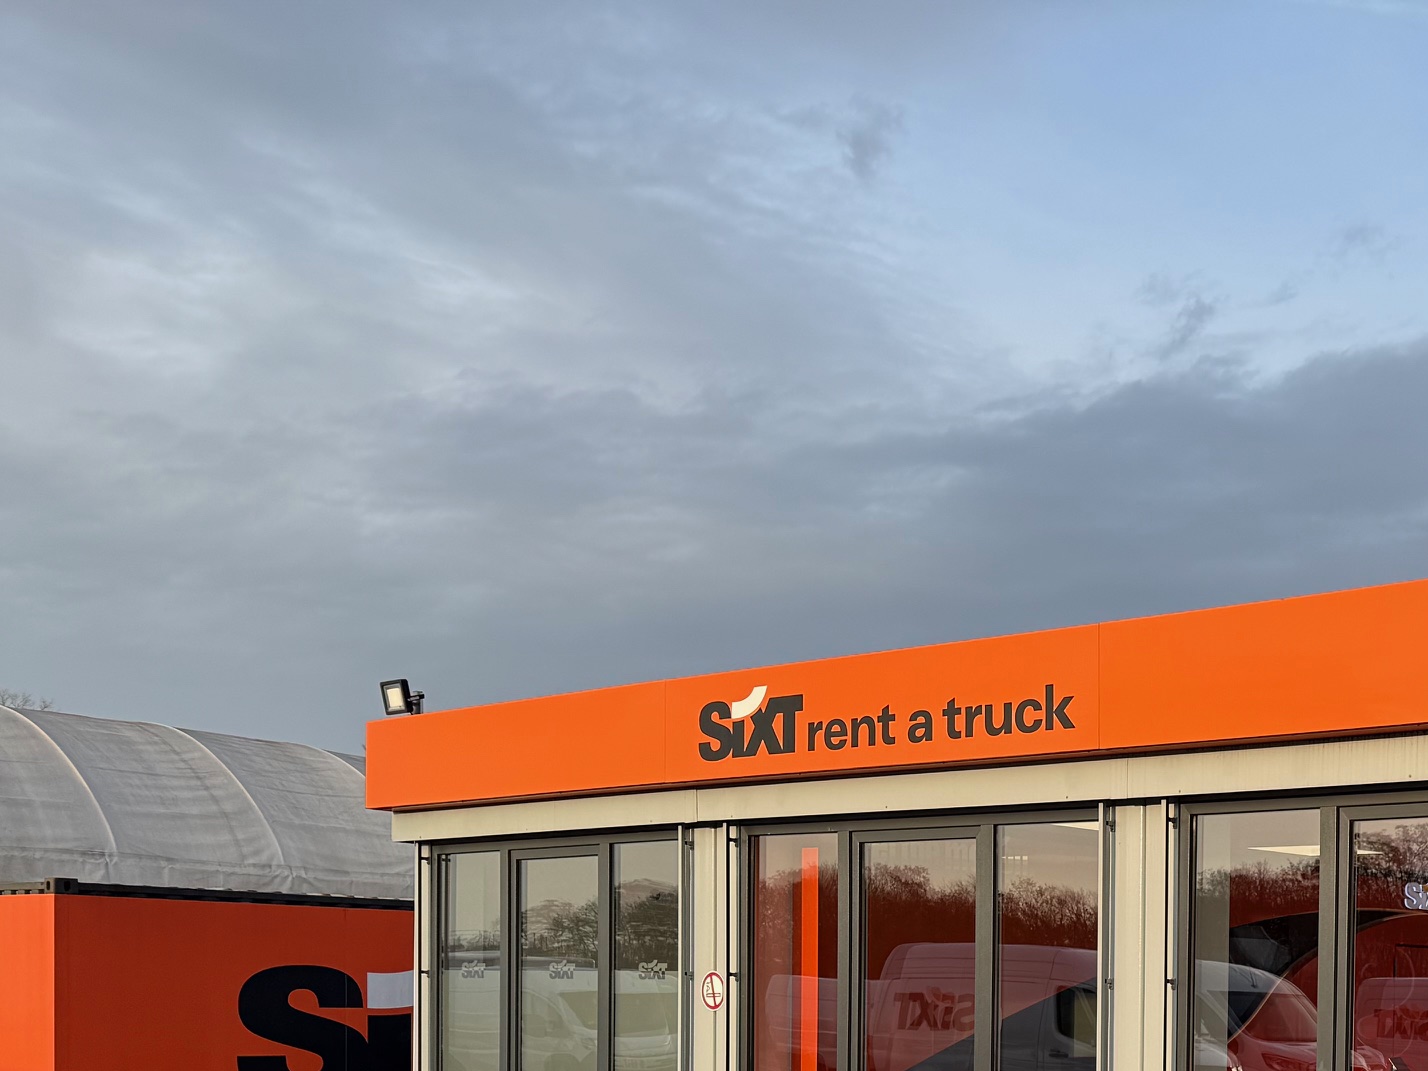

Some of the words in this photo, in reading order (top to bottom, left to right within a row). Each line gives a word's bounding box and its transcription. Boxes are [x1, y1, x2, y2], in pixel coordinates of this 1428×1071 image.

[698, 685, 803, 762] SIXT
[807, 704, 896, 751] rent
[907, 709, 933, 744] a
[942, 683, 1076, 740] truck
[462, 960, 486, 978] SIXT
[549, 960, 575, 979] SIXT
[638, 960, 667, 980] SIXT
